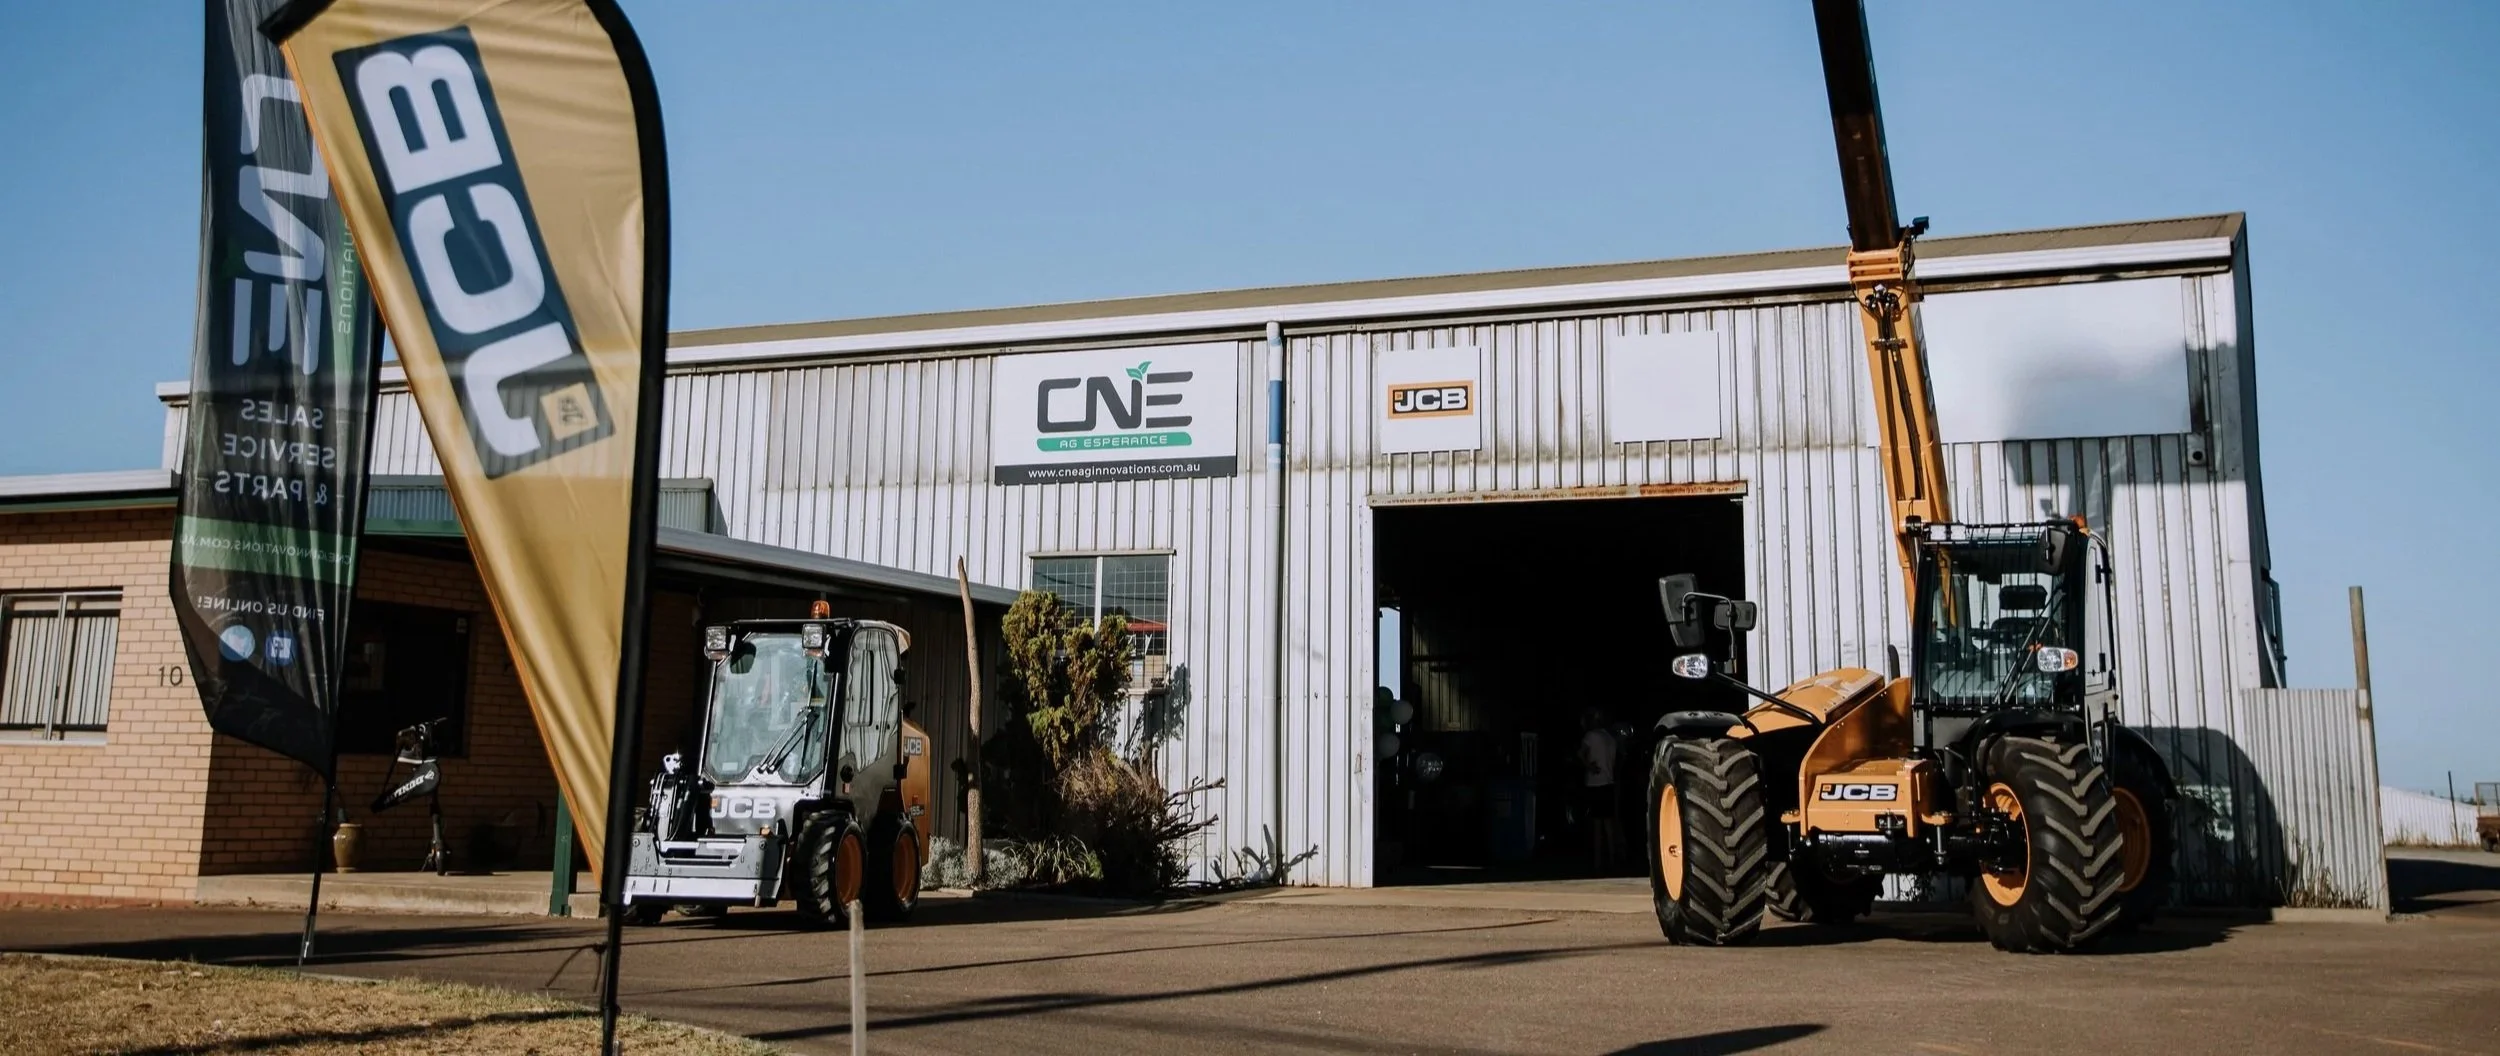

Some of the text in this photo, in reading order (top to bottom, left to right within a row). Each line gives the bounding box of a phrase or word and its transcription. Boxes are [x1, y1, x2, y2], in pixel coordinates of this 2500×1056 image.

[1037, 371, 1193, 433] CNE
[1394, 387, 1467, 412] JCB
[1059, 434, 1168, 449] AG ESPERANCE
[1028, 463, 1201, 478] www.cneaginnovations.com.au
[158, 666, 183, 688] 10
[904, 737, 922, 754] JCB
[1820, 784, 1897, 800] JCB
[710, 797, 776, 819] JCB
